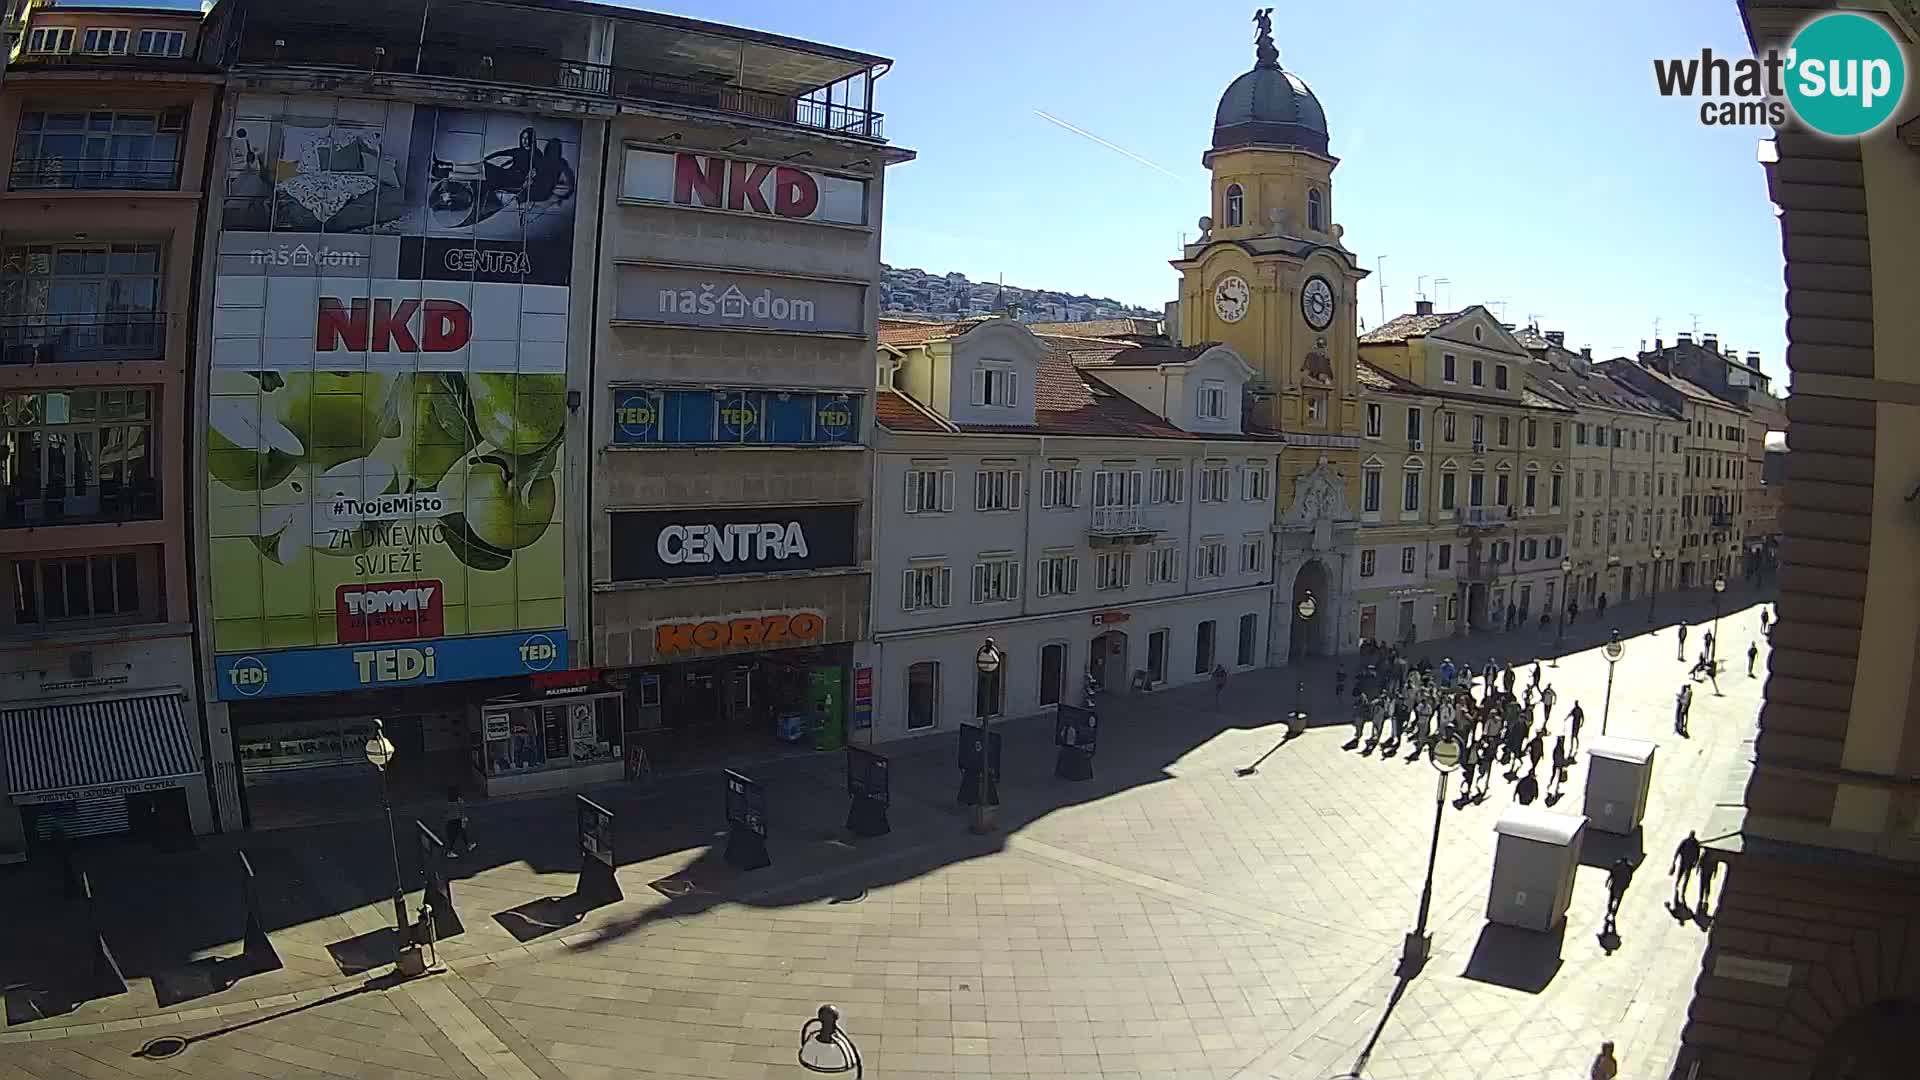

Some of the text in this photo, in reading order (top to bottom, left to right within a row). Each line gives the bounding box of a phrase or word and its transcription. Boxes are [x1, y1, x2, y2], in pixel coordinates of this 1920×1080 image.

[674, 152, 819, 218] NKD
[315, 246, 361, 267] dom
[444, 248, 532, 274] CENTRA
[659, 281, 815, 322] naš dom
[316, 296, 473, 352] NKD
[616, 407, 656, 424] TEDi
[333, 497, 442, 517] #TvojeMisto
[328, 523, 446, 550] ZA DNEVNO
[657, 522, 808, 564] CENTRA
[355, 548, 424, 576] SVJEŽE
[344, 587, 434, 615] TOMMY
[656, 613, 824, 654] KORZO
[353, 647, 436, 683] TEDi
[519, 642, 557, 662] TEDi
[229, 666, 268, 685] TEDi
